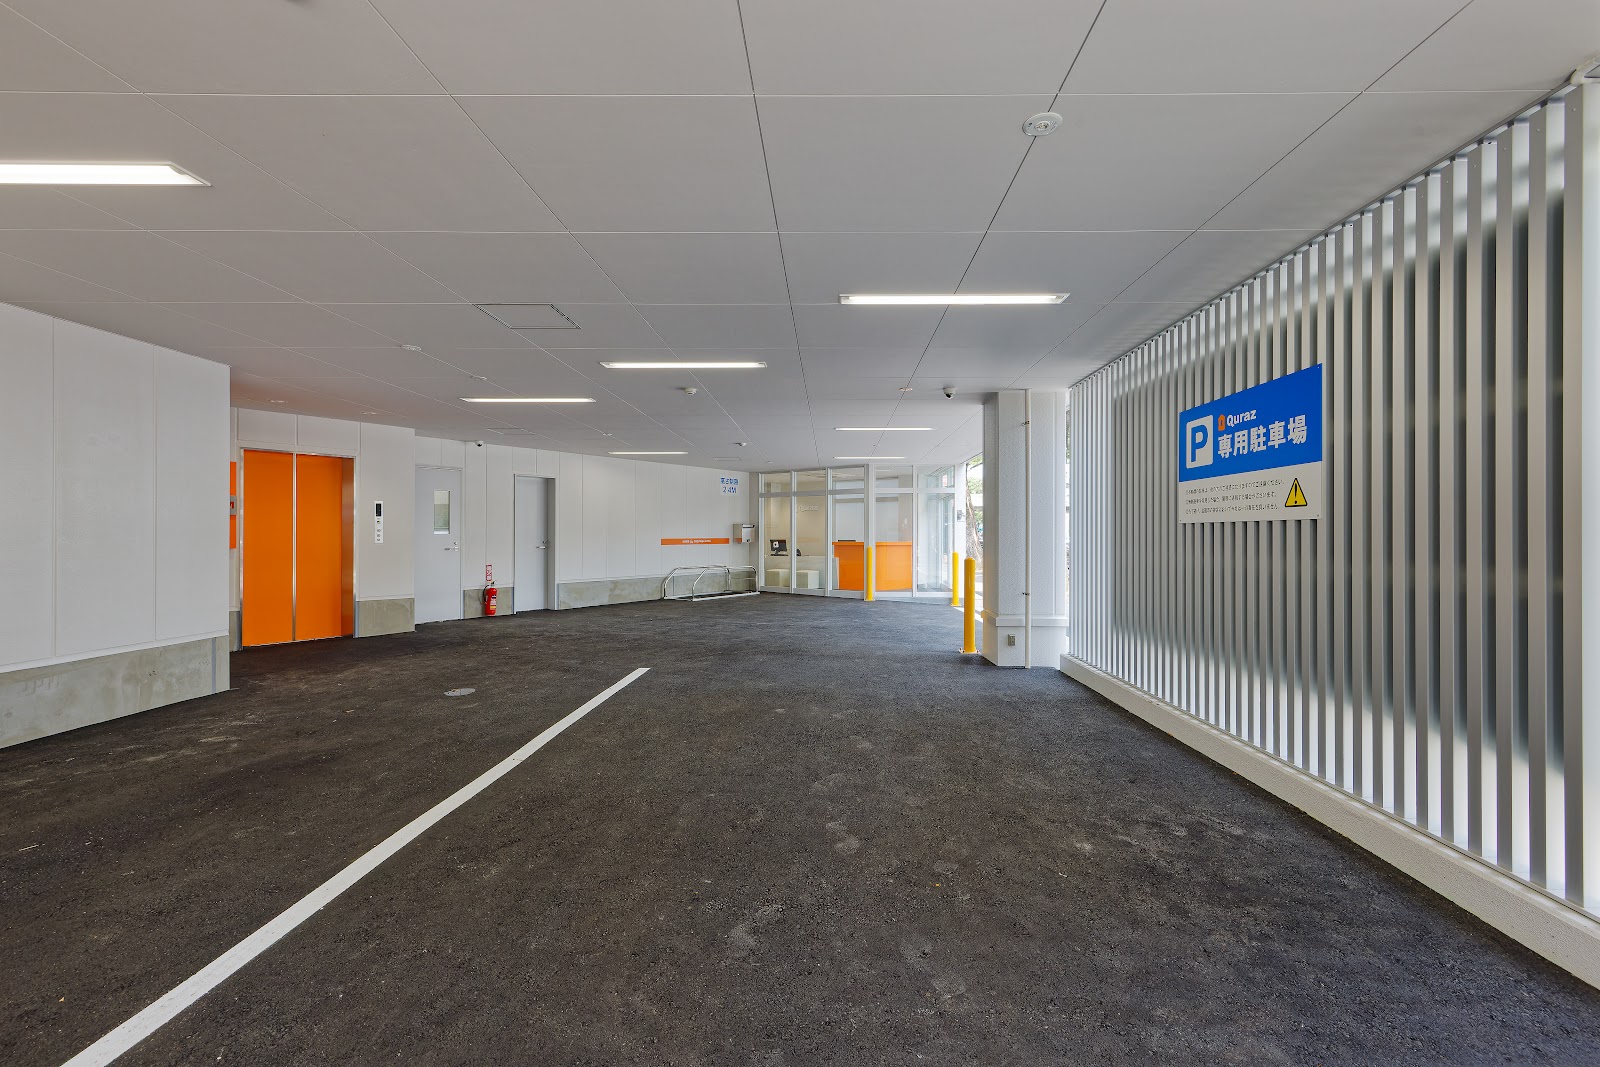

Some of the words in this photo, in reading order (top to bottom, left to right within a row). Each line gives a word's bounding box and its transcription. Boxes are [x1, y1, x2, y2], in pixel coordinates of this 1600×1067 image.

[1217, 414, 1308, 459] 専用駐車場
[1227, 409, 1257, 428] Quraz
[1190, 423, 1209, 463] P
